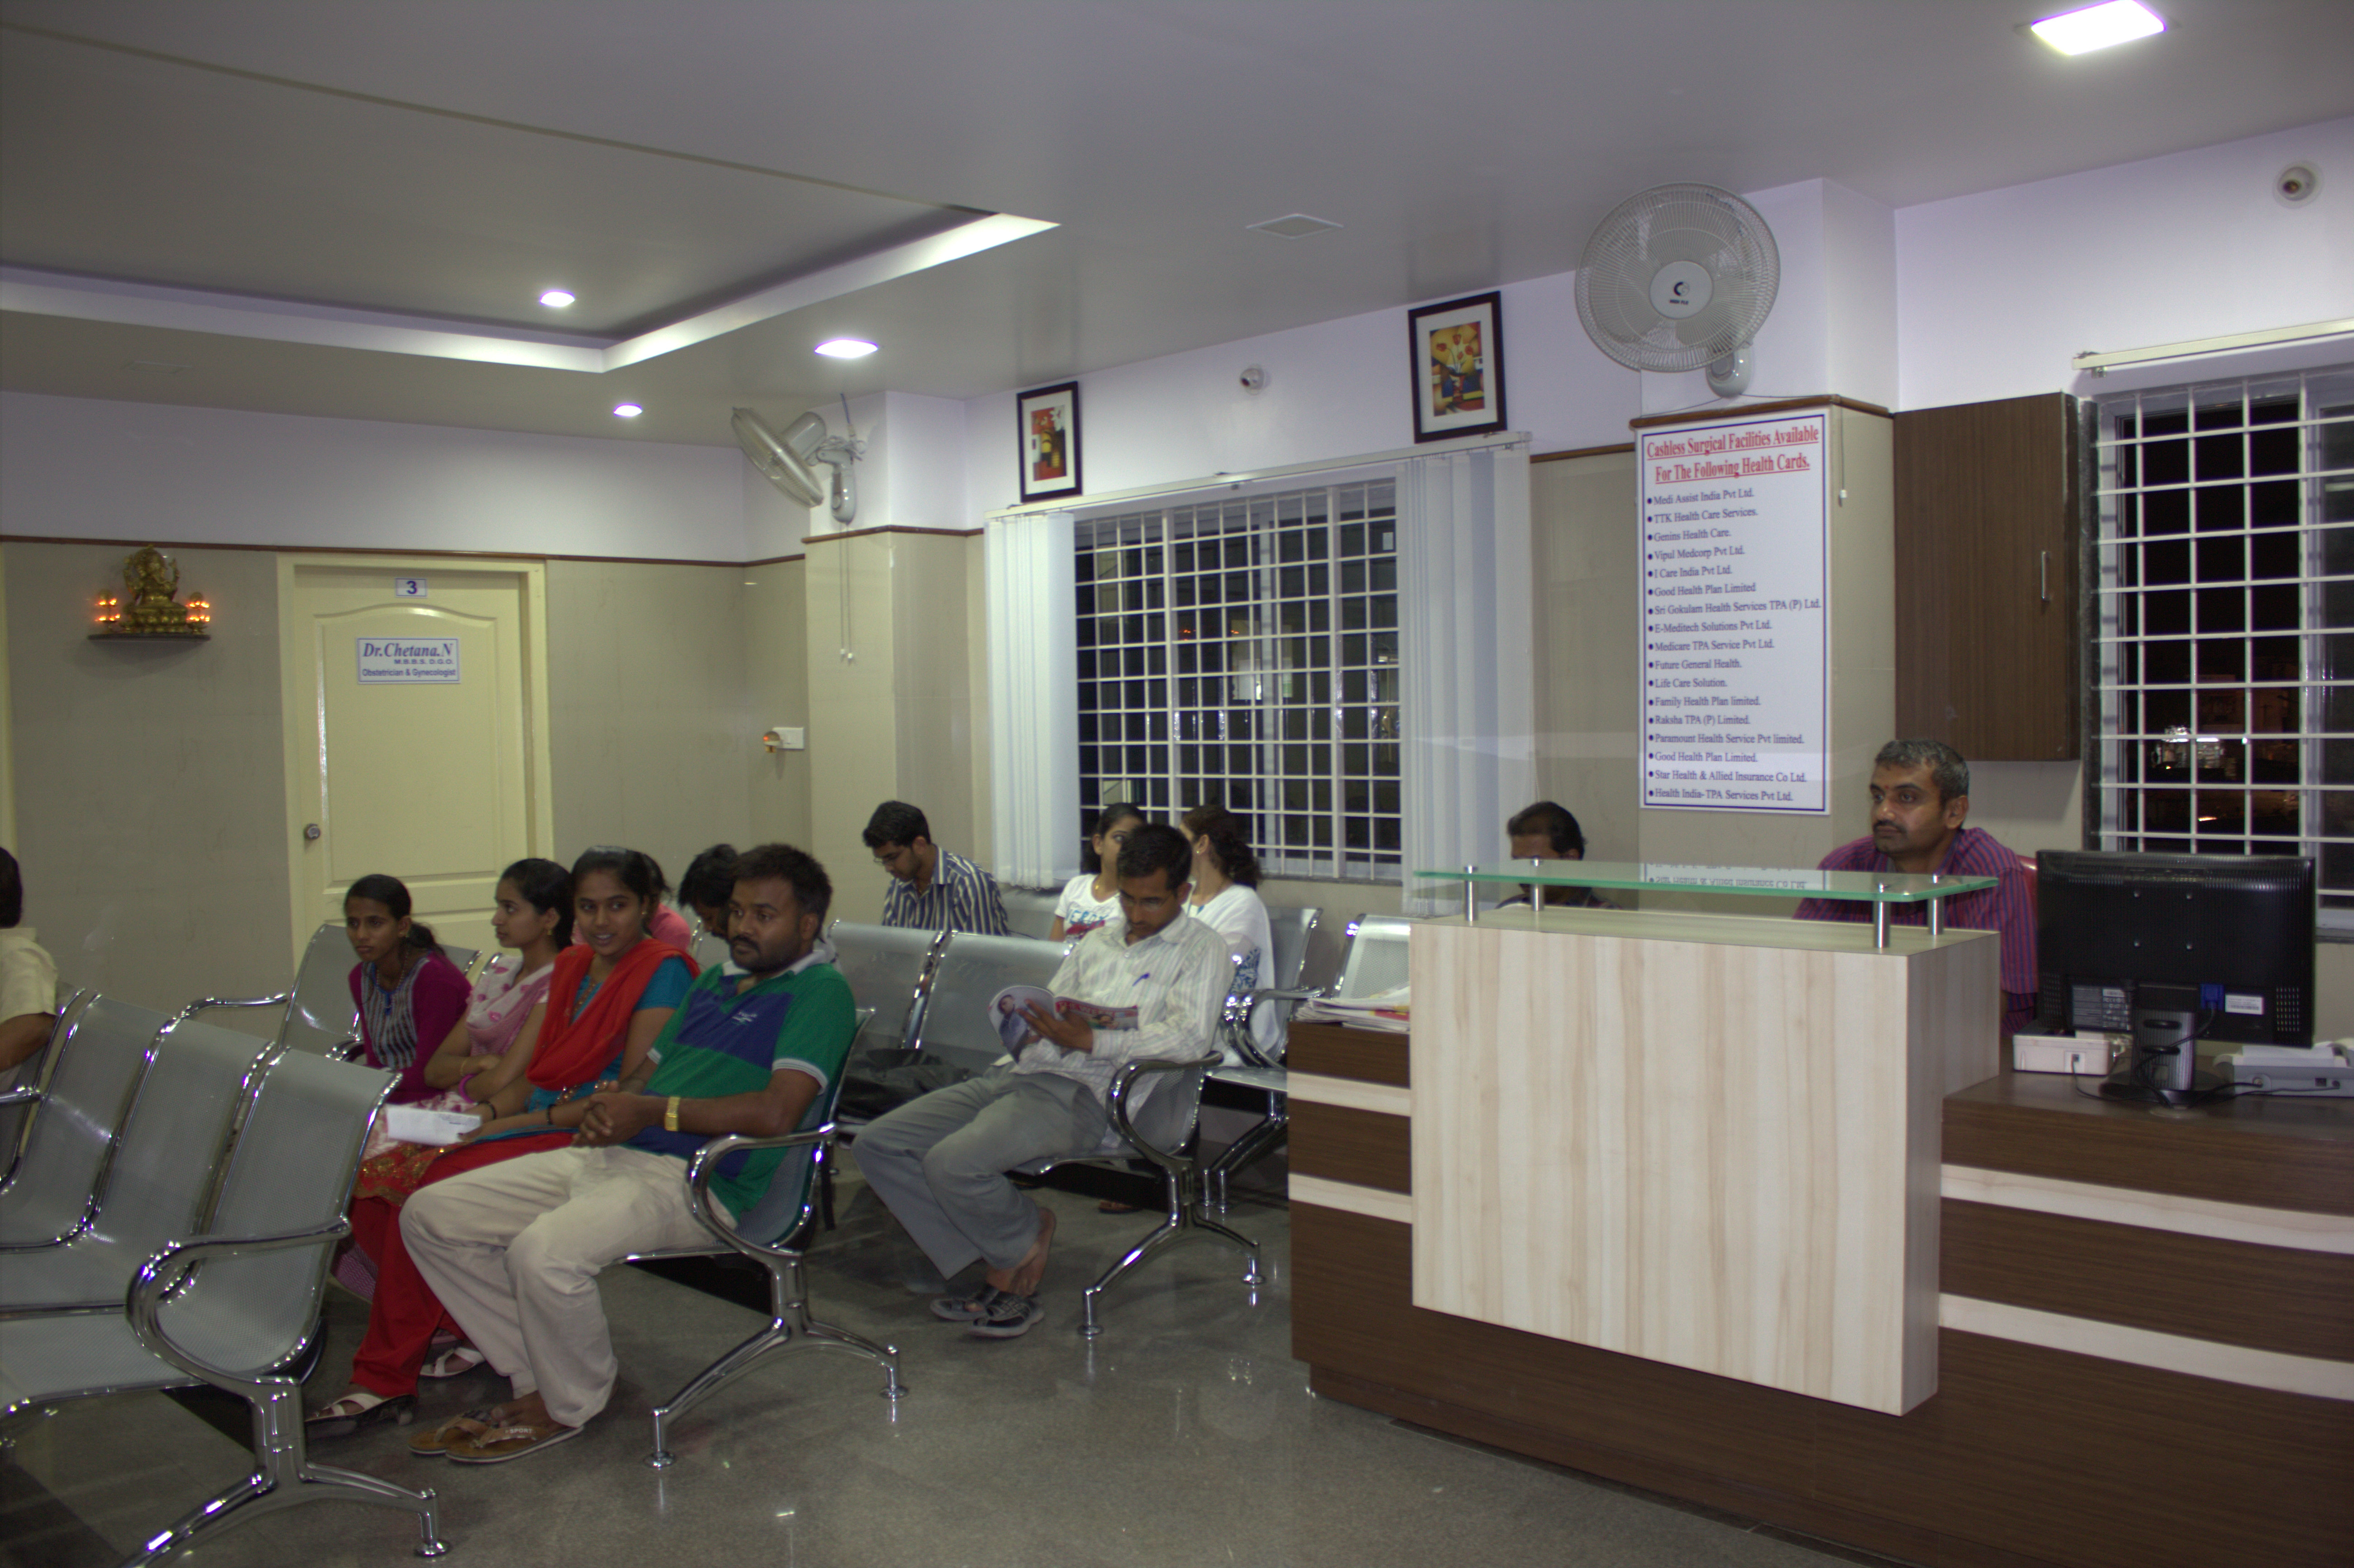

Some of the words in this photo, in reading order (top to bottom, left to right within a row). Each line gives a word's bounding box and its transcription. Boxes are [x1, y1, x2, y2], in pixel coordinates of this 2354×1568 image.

[1647, 440, 1685, 458] Cashless
[1688, 434, 1725, 456] Surgical
[1729, 430, 1771, 449] Facilities
[1773, 425, 1819, 444] Available
[1656, 467, 1672, 481] For
[1674, 464, 1692, 480] The
[1694, 459, 1739, 478] Following
[1742, 455, 1774, 473] Health
[1777, 453, 1810, 470] Cards.
[1654, 495, 1673, 505] Medi
[1675, 494, 1698, 503] Assist
[1701, 491, 1720, 501] India
[1723, 490, 1736, 499] Pvt
[1738, 488, 1754, 498] Ltd.
[1654, 514, 1672, 523] TTK
[1674, 511, 1699, 522] Health
[1701, 510, 1720, 519] Care
[1722, 509, 1758, 518] Services.
[1683, 529, 1708, 539] Health
[1710, 529, 1730, 538] Care.
[1654, 550, 1675, 562] Vipul
[1677, 549, 1711, 559] Medcorp
[1714, 547, 1727, 556] Pvt
[1729, 545, 1744, 555] Ltd.
[1659, 569, 1677, 578] Care
[1680, 567, 1699, 577] India
[1701, 567, 1714, 575] Pvt
[1716, 565, 1732, 575] Ltd.
[406, 581, 418, 595] 3
[1654, 587, 1675, 596] Good
[1677, 586, 1702, 595] Health
[1705, 585, 1722, 594] Plan
[1655, 606, 1665, 615] Sri
[1668, 605, 1703, 614] Gokulam
[1705, 603, 1731, 612] Health
[1733, 602, 1767, 611] Services
[1769, 601, 1787, 610] TPA
[1789, 600, 1802, 610] (P)
[1804, 599, 1820, 609] Ltd.
[1655, 623, 1699, 633] E-Meditech
[1701, 622, 1738, 631] Solutions
[1740, 621, 1754, 630] Pvt
[1756, 620, 1772, 629] Ltd.
[1655, 642, 1690, 651] Medicare
[1692, 641, 1709, 650] TPA
[1711, 641, 1740, 649] Service
[1743, 639, 1756, 649] Pvt
[1758, 639, 1774, 648] Ltd.
[1655, 661, 1679, 669] Future
[1681, 660, 1711, 669] General
[1714, 659, 1741, 668] Health.
[412, 669, 456, 678] Gynecologist
[1655, 679, 1671, 688] Life
[1673, 679, 1691, 687] Care
[1693, 678, 1727, 687] Solution.
[1655, 697, 1681, 708] Family
[1684, 697, 1709, 705] Health
[1711, 696, 1728, 705] Plan
[1731, 696, 1760, 705] limited.
[1655, 715, 1682, 724] Raksha
[1685, 715, 1701, 724] TPA
[1703, 715, 1715, 725] (P)
[1718, 715, 1750, 724] Limited.
[1655, 734, 1696, 743] Paramount
[1698, 734, 1723, 743] Health
[1726, 734, 1755, 743] Service
[1758, 734, 1771, 743] Pvt
[1773, 734, 1804, 743] limited.
[1654, 752, 1675, 761] Good
[1678, 752, 1702, 761] Health
[1706, 752, 1722, 761] Plan
[1725, 753, 1758, 762] Limited.
[1655, 770, 1670, 779] Star
[1673, 771, 1696, 779] Health
[1700, 771, 1706, 780] &
[1709, 772, 1733, 781] Allied
[1735, 772, 1773, 781] Insurance
[1776, 772, 1787, 782] Co
[1790, 772, 1806, 782] Ltd.
[1655, 788, 1679, 797] Health
[1706, 790, 1722, 798] TPA
[1725, 790, 1758, 800] Services
[1761, 791, 1774, 800] Pvt
[1777, 791, 1793, 801] Ltd.
